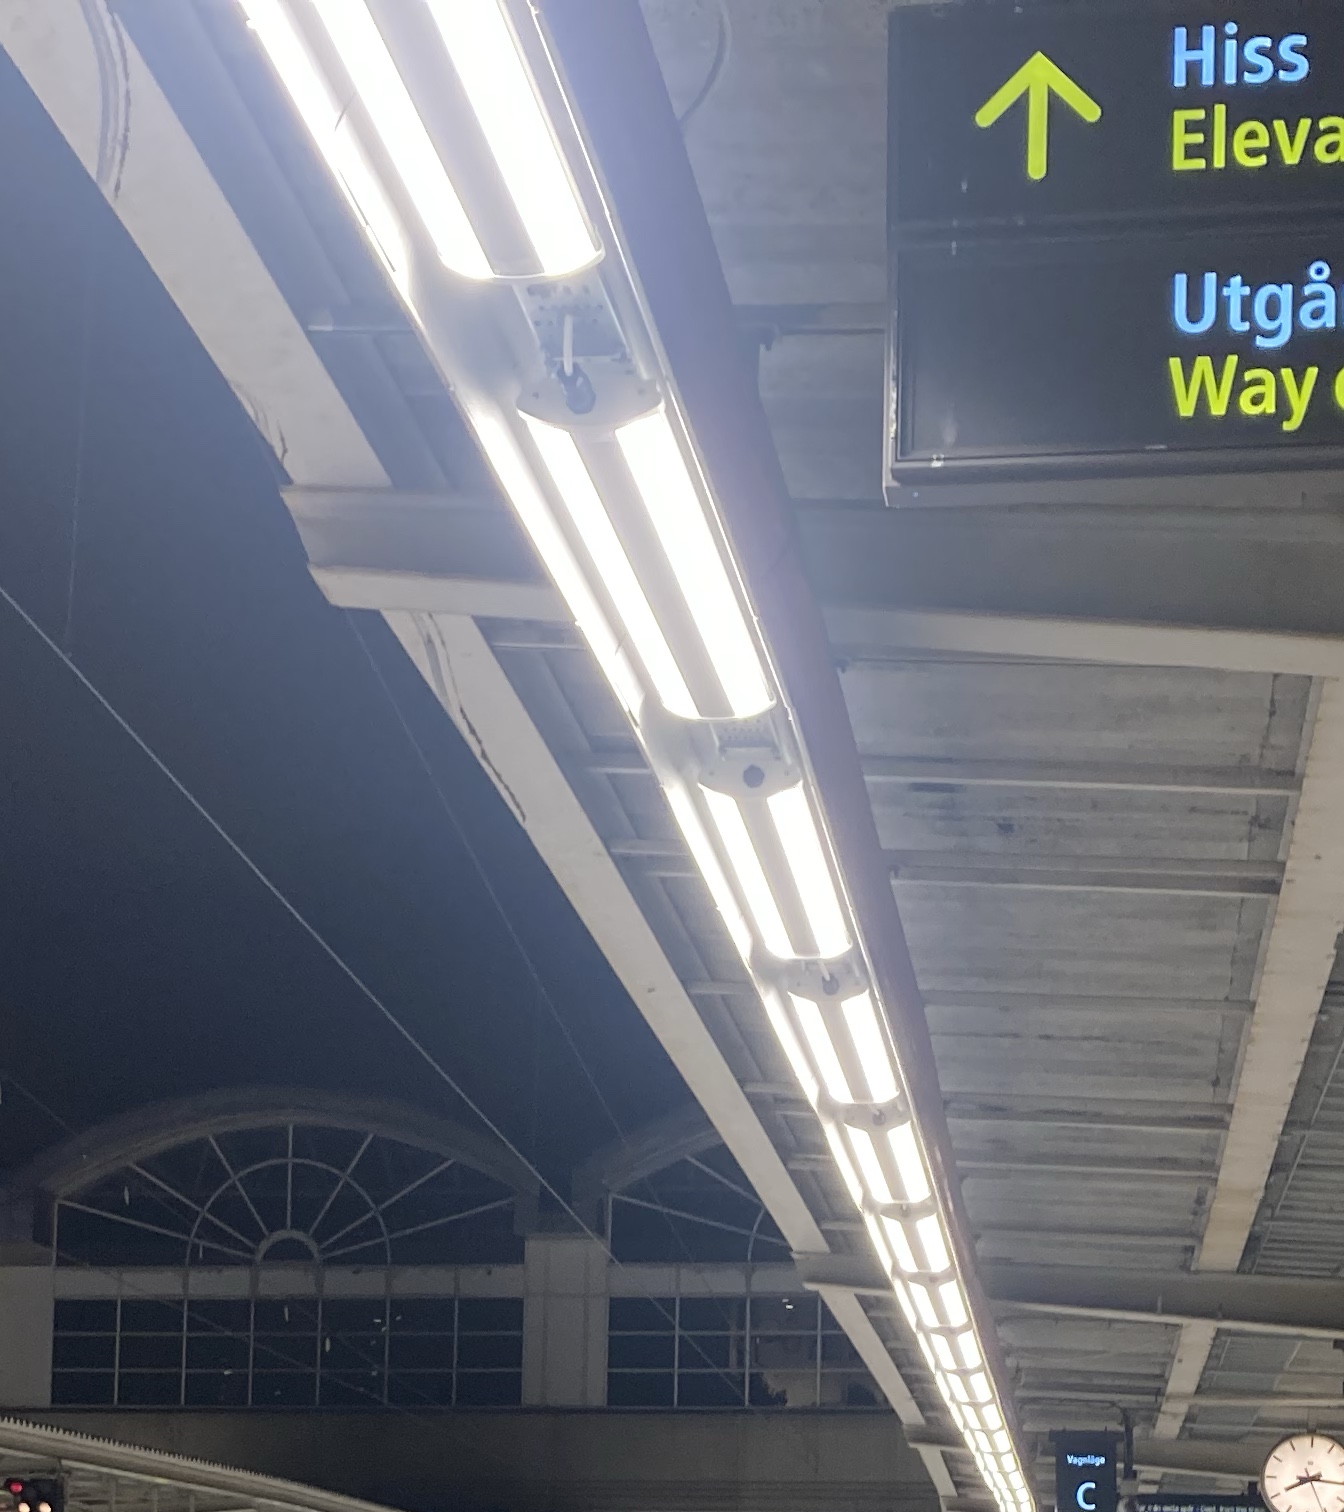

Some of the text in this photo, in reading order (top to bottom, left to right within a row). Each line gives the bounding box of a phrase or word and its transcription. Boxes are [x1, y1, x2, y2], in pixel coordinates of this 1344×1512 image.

[1171, 21, 1310, 88] Hiss
[1167, 354, 1319, 431] Way
[1067, 1454, 1106, 1467] Vagnläge
[1076, 1481, 1096, 1511] C
